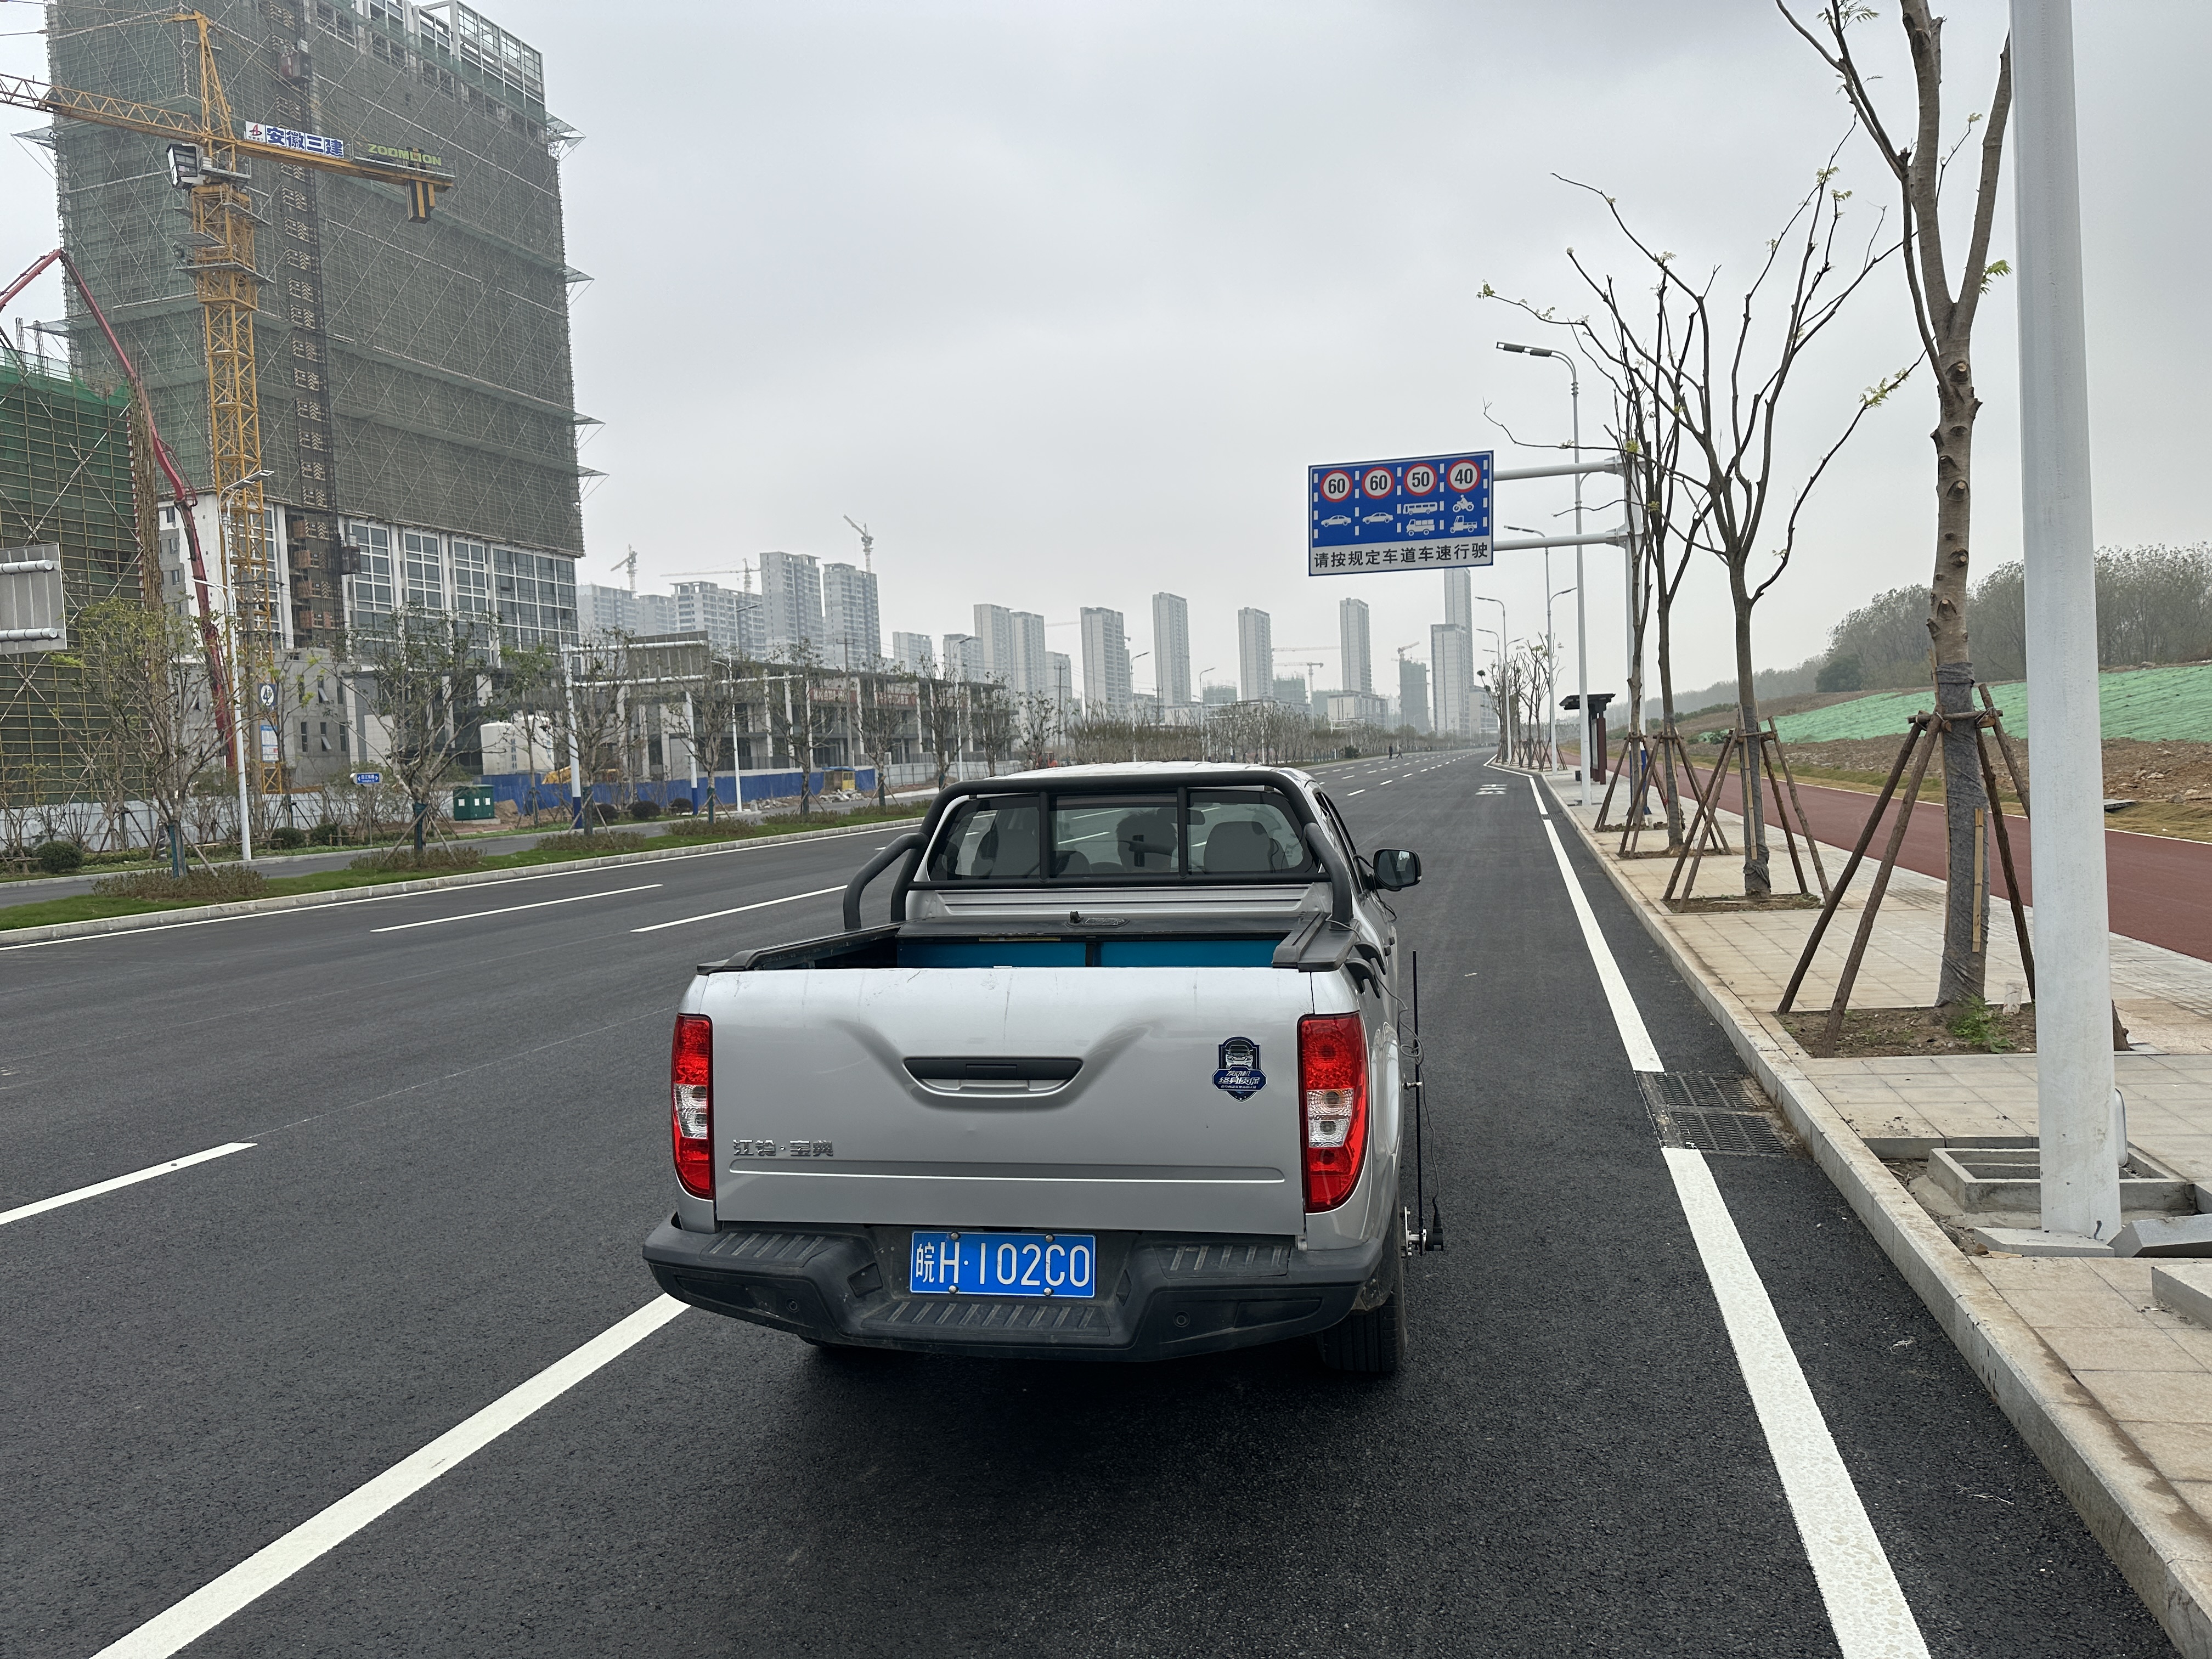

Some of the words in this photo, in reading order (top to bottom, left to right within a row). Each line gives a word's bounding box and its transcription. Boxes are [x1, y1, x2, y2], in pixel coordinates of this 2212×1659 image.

[267, 127, 343, 157] 安徽三建
[368, 143, 442, 166] ZOOMLION
[1328, 478, 1346, 494] 60
[1370, 475, 1387, 490] 60
[1412, 471, 1430, 488] 50
[1454, 469, 1473, 484] 40
[1314, 542, 1488, 568] 请按规定车道车速行驶
